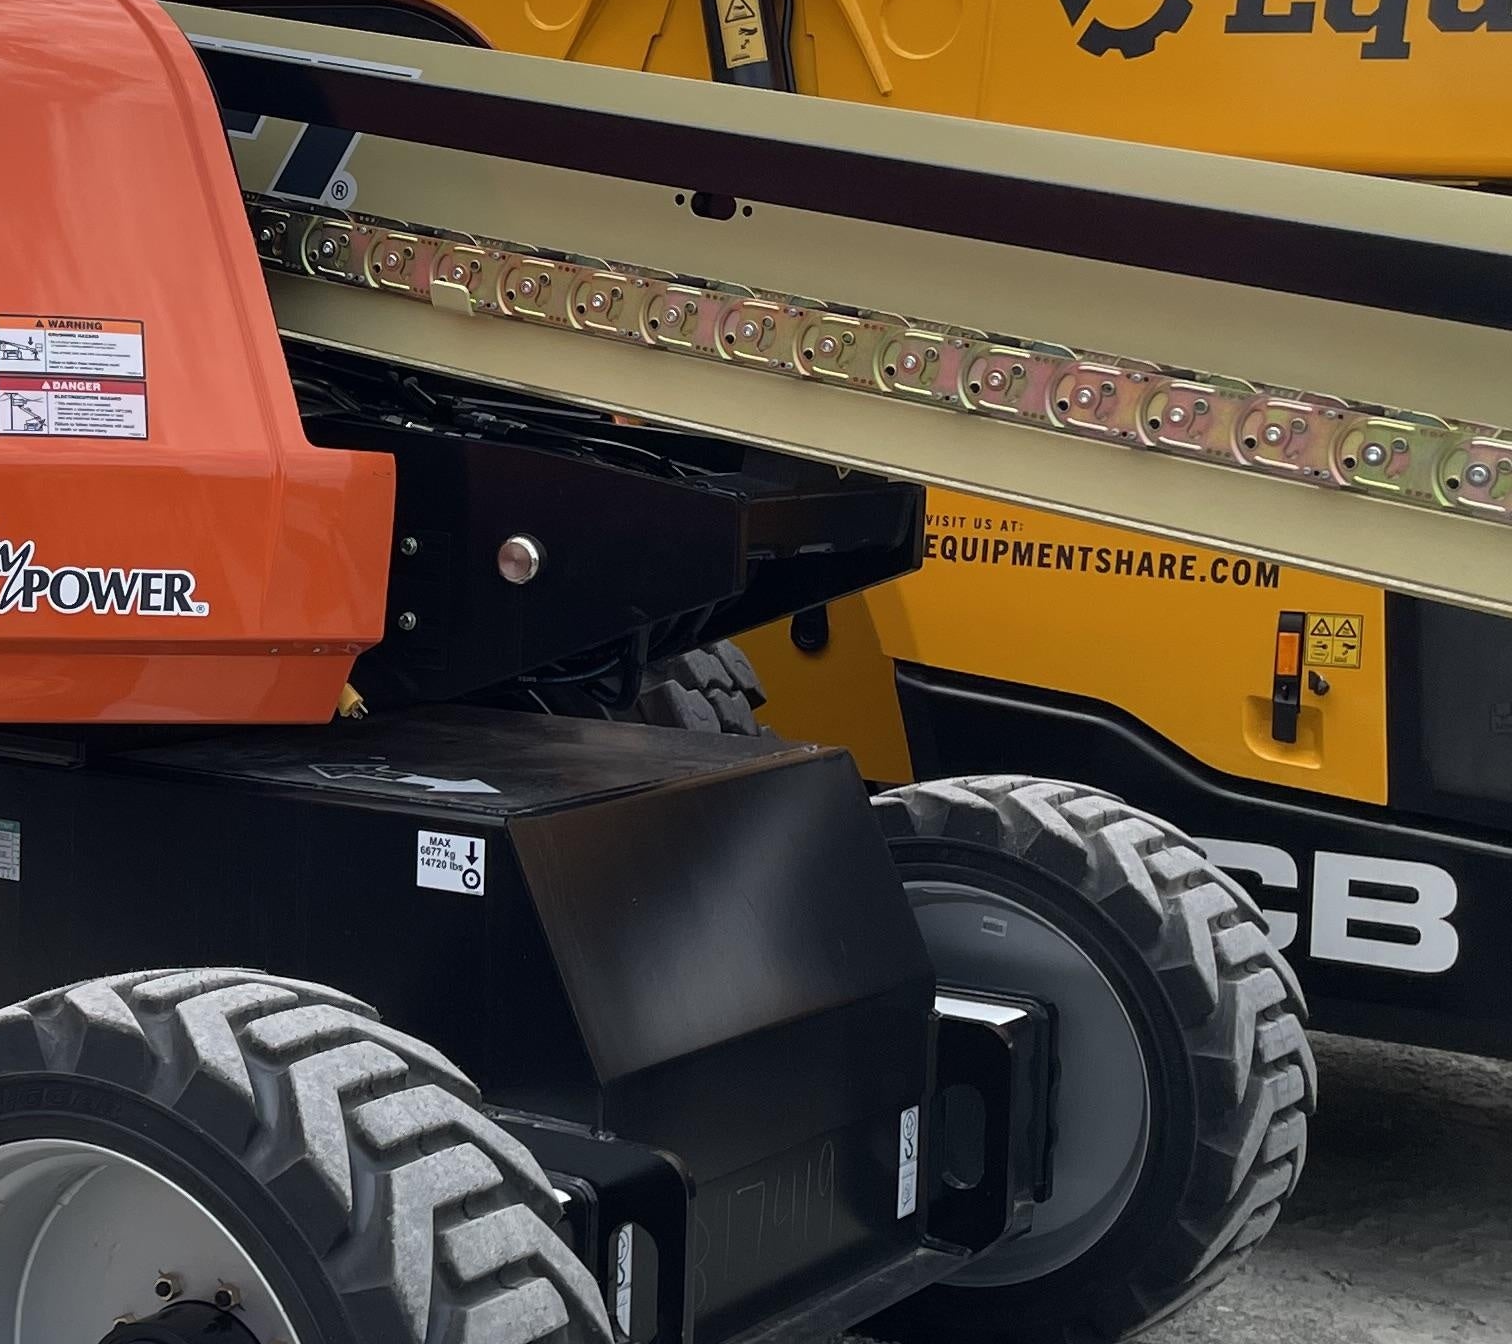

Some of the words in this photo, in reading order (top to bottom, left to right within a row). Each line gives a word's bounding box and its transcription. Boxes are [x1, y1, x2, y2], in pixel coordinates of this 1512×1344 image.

[48, 319, 103, 331] WARNING
[52, 381, 101, 391] DANGER
[925, 514, 967, 528] VISIT
[974, 518, 992, 530] US
[1000, 520, 1024, 532] AT:
[923, 533, 1280, 589] EQUIPMENTSHARE.COM
[429, 836, 451, 848] MAX
[420, 845, 442, 857] 6677
[444, 849, 456, 861] kg
[420, 857, 447, 869] 14720
[449, 861, 463, 871] lbs
